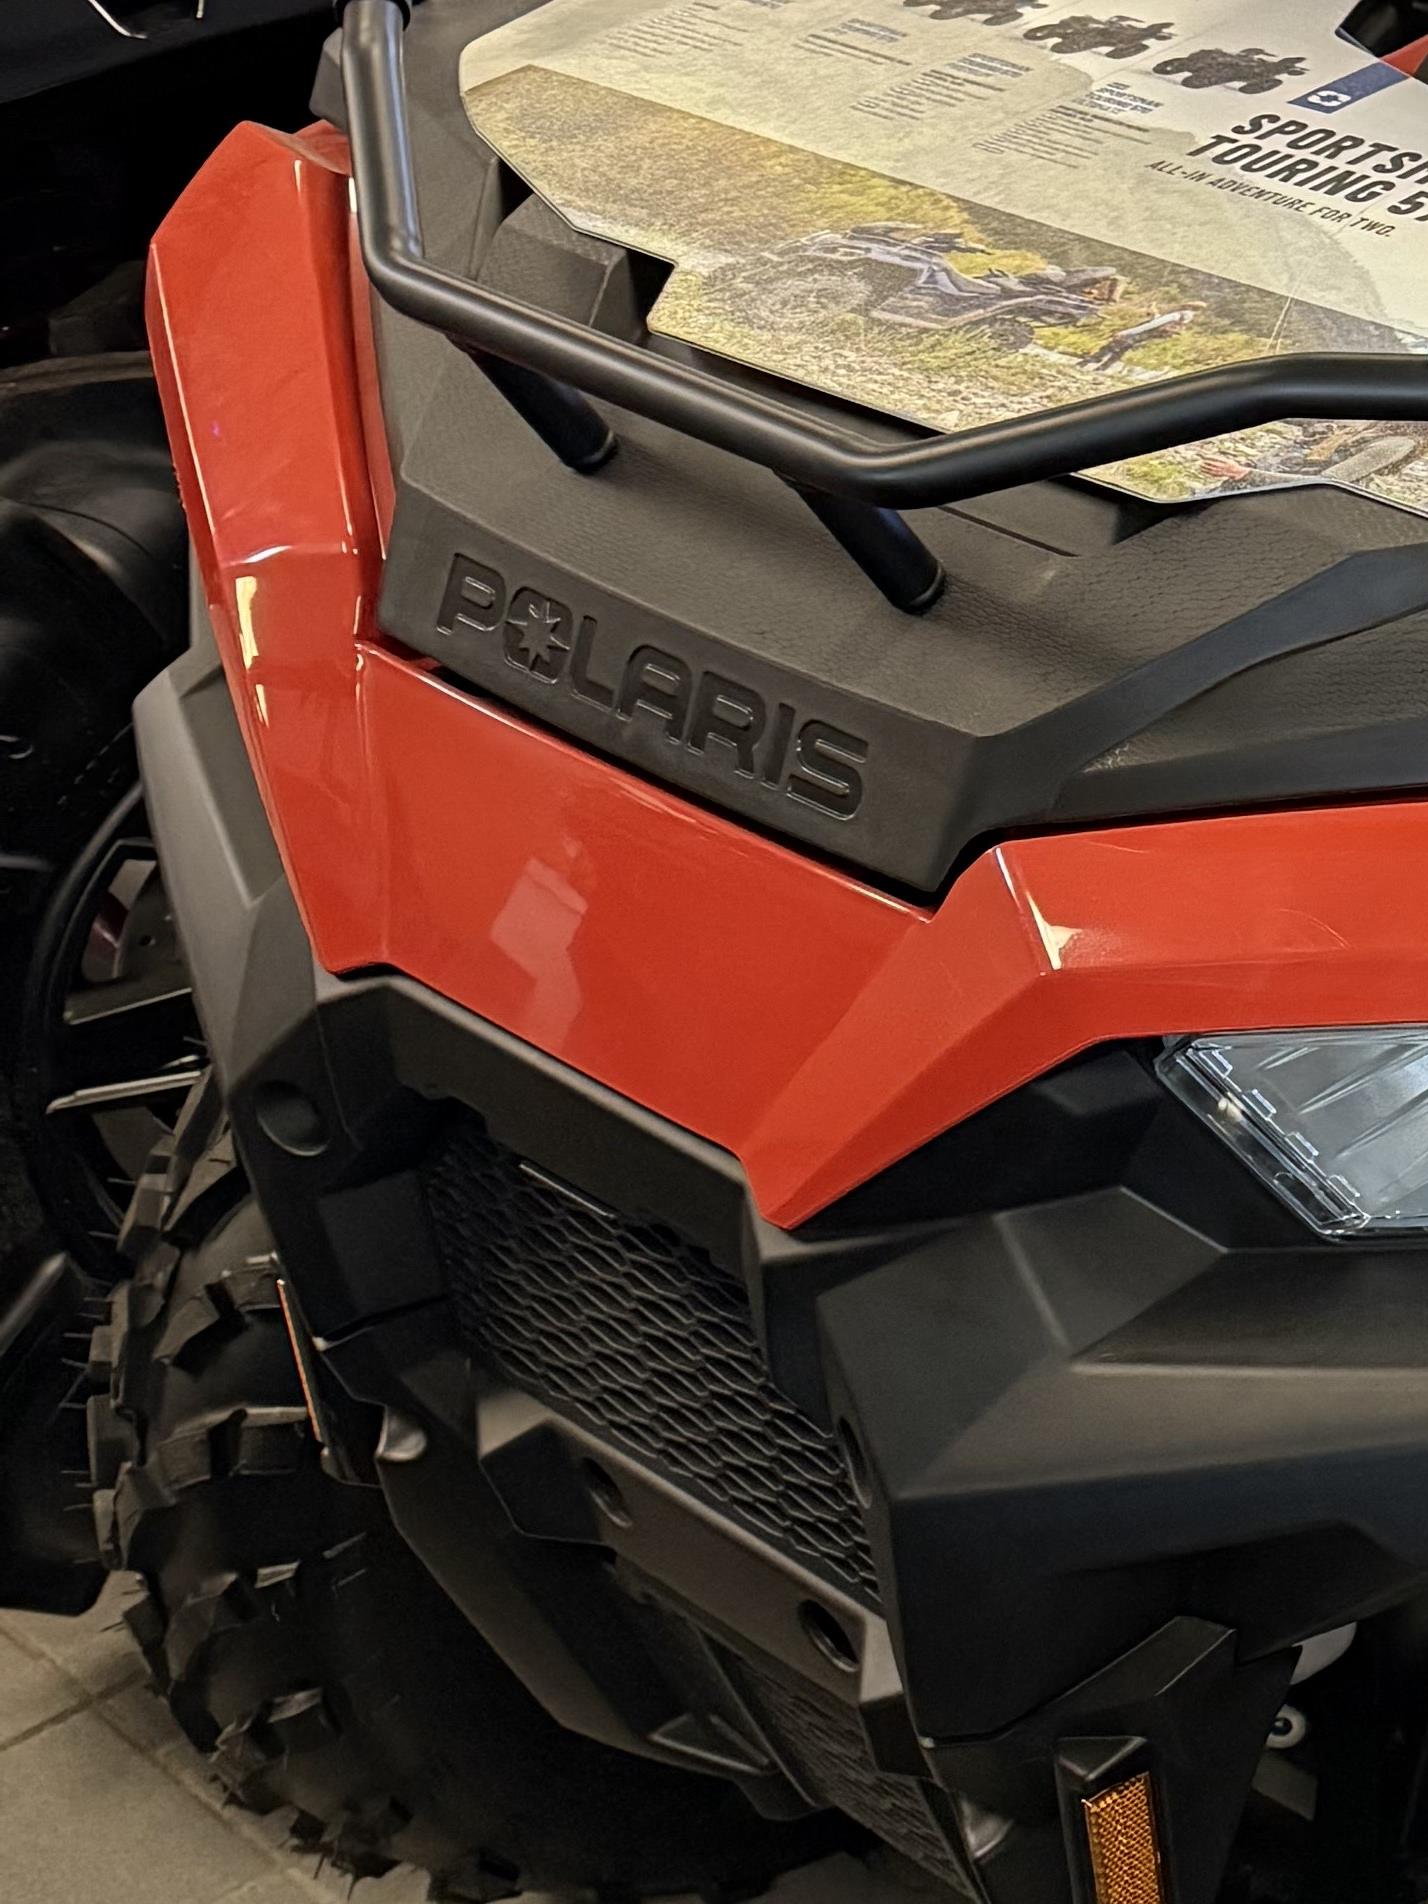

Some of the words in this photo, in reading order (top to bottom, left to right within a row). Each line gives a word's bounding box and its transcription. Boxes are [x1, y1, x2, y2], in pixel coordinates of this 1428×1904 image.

[1147, 160, 1209, 183] ALL-IN
[1208, 175, 1315, 214] ADVENTURE
[1313, 206, 1353, 225] FOR
[1348, 216, 1397, 238] TWO.
[1186, 134, 1396, 203] TOURING
[436, 553, 868, 821] POLARIS
